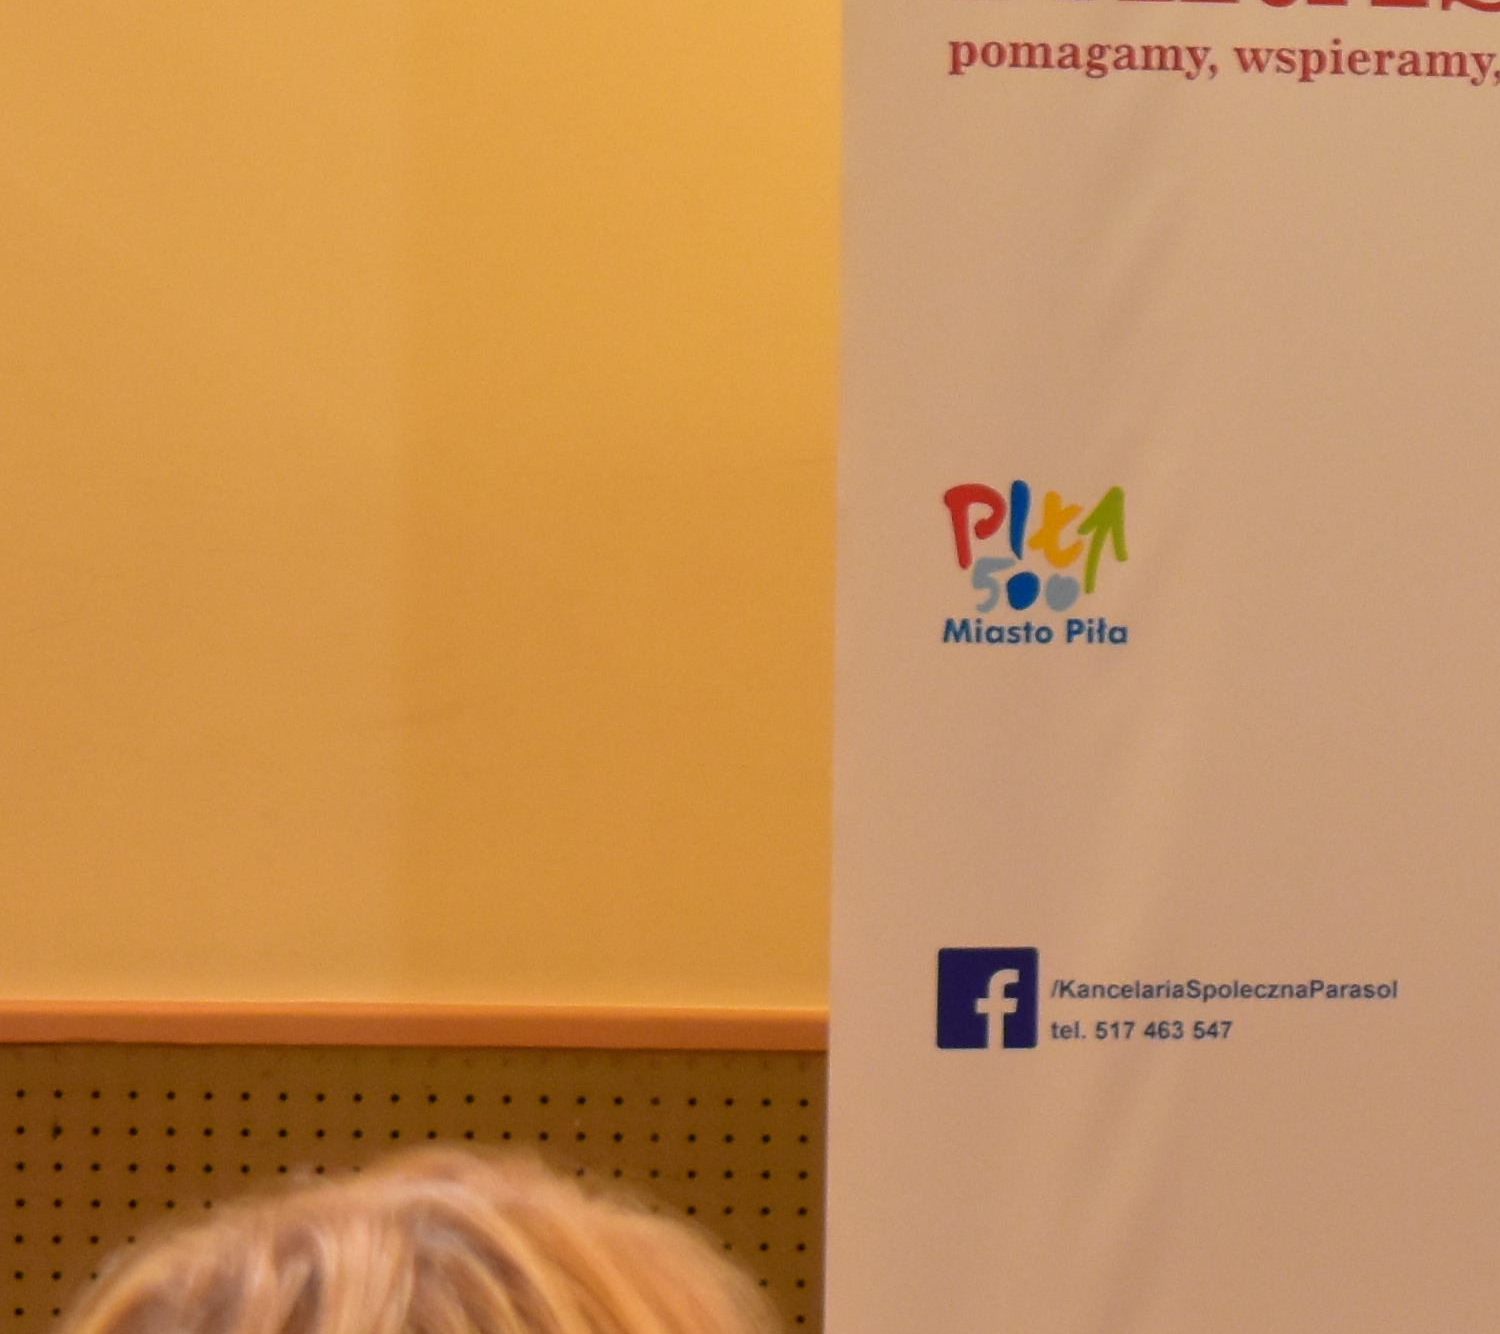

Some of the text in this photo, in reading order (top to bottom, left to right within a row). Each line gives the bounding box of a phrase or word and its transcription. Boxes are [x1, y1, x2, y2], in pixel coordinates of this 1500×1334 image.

[947, 34, 1220, 80] pomagamy,
[944, 618, 1127, 644] Miasto Piła
[1051, 979, 1398, 1003] /KancelariaSpolecznaParasol
[1051, 1021, 1232, 1040] tel. 517 463 547
